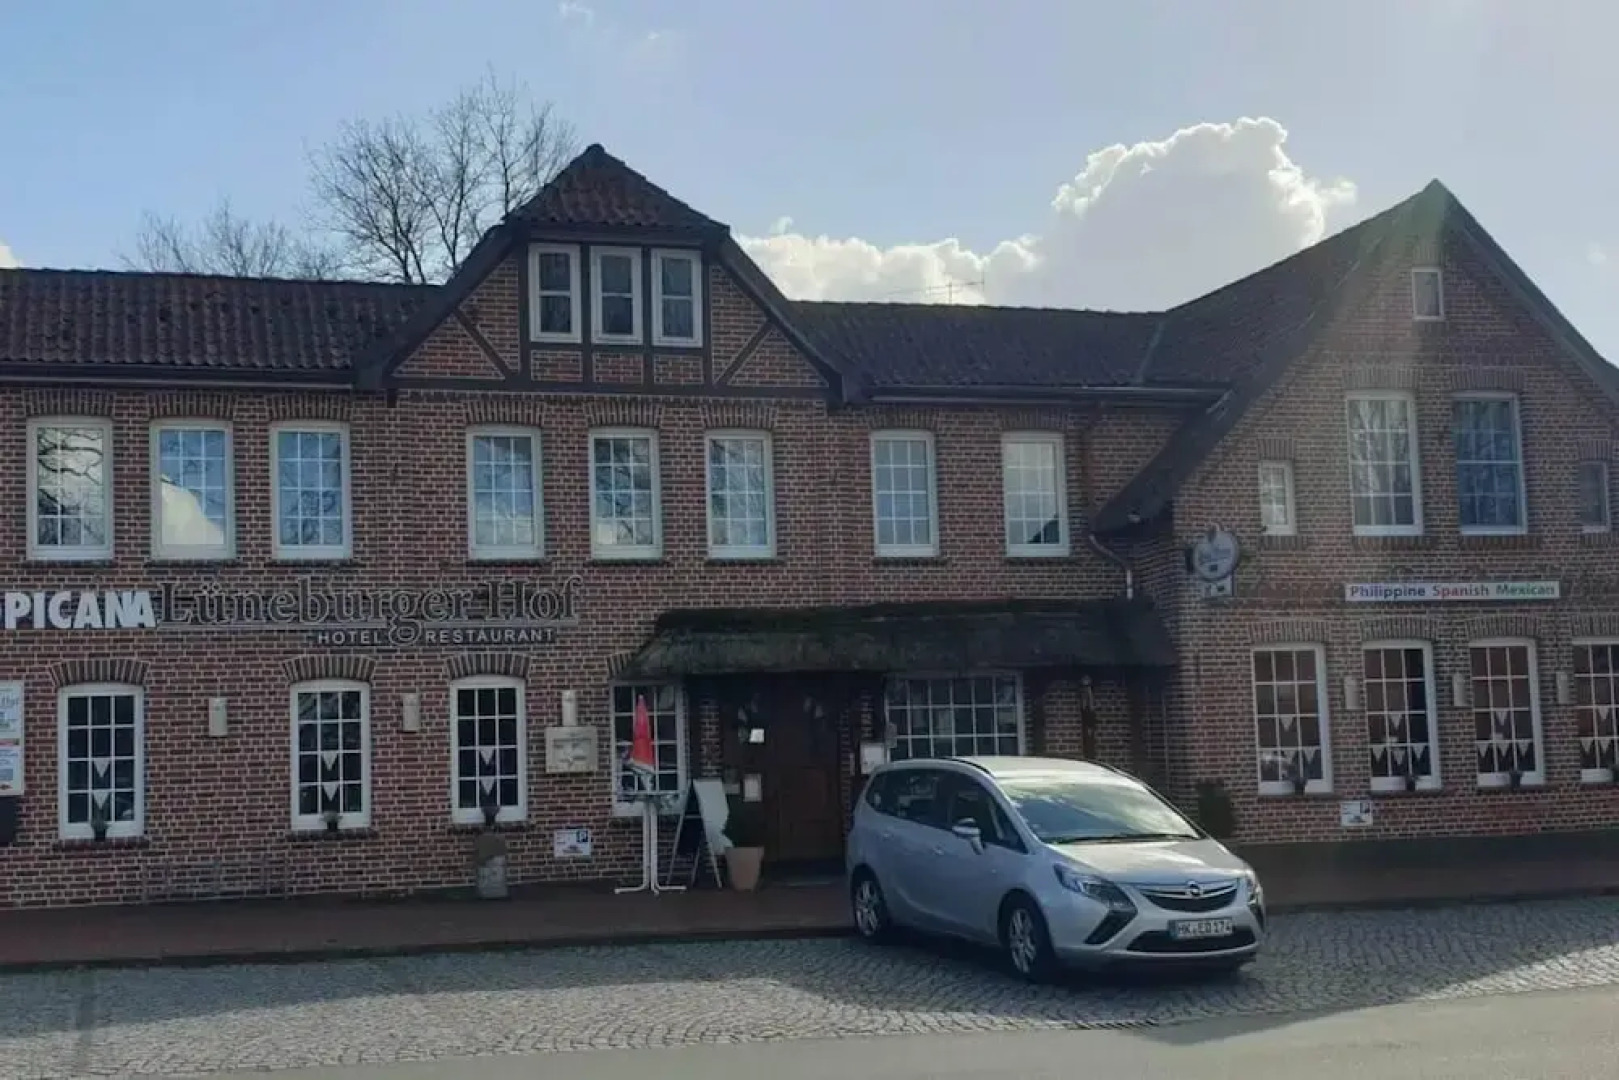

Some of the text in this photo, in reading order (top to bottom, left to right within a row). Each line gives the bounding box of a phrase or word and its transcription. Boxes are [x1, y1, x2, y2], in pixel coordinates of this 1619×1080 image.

[1351, 582, 1555, 599] Philippine Spanish Mexican
[4, 590, 156, 629] PICANA
[157, 575, 583, 647] Lüneburger Hof
[317, 628, 554, 645] HOTEL RESTAURANT
